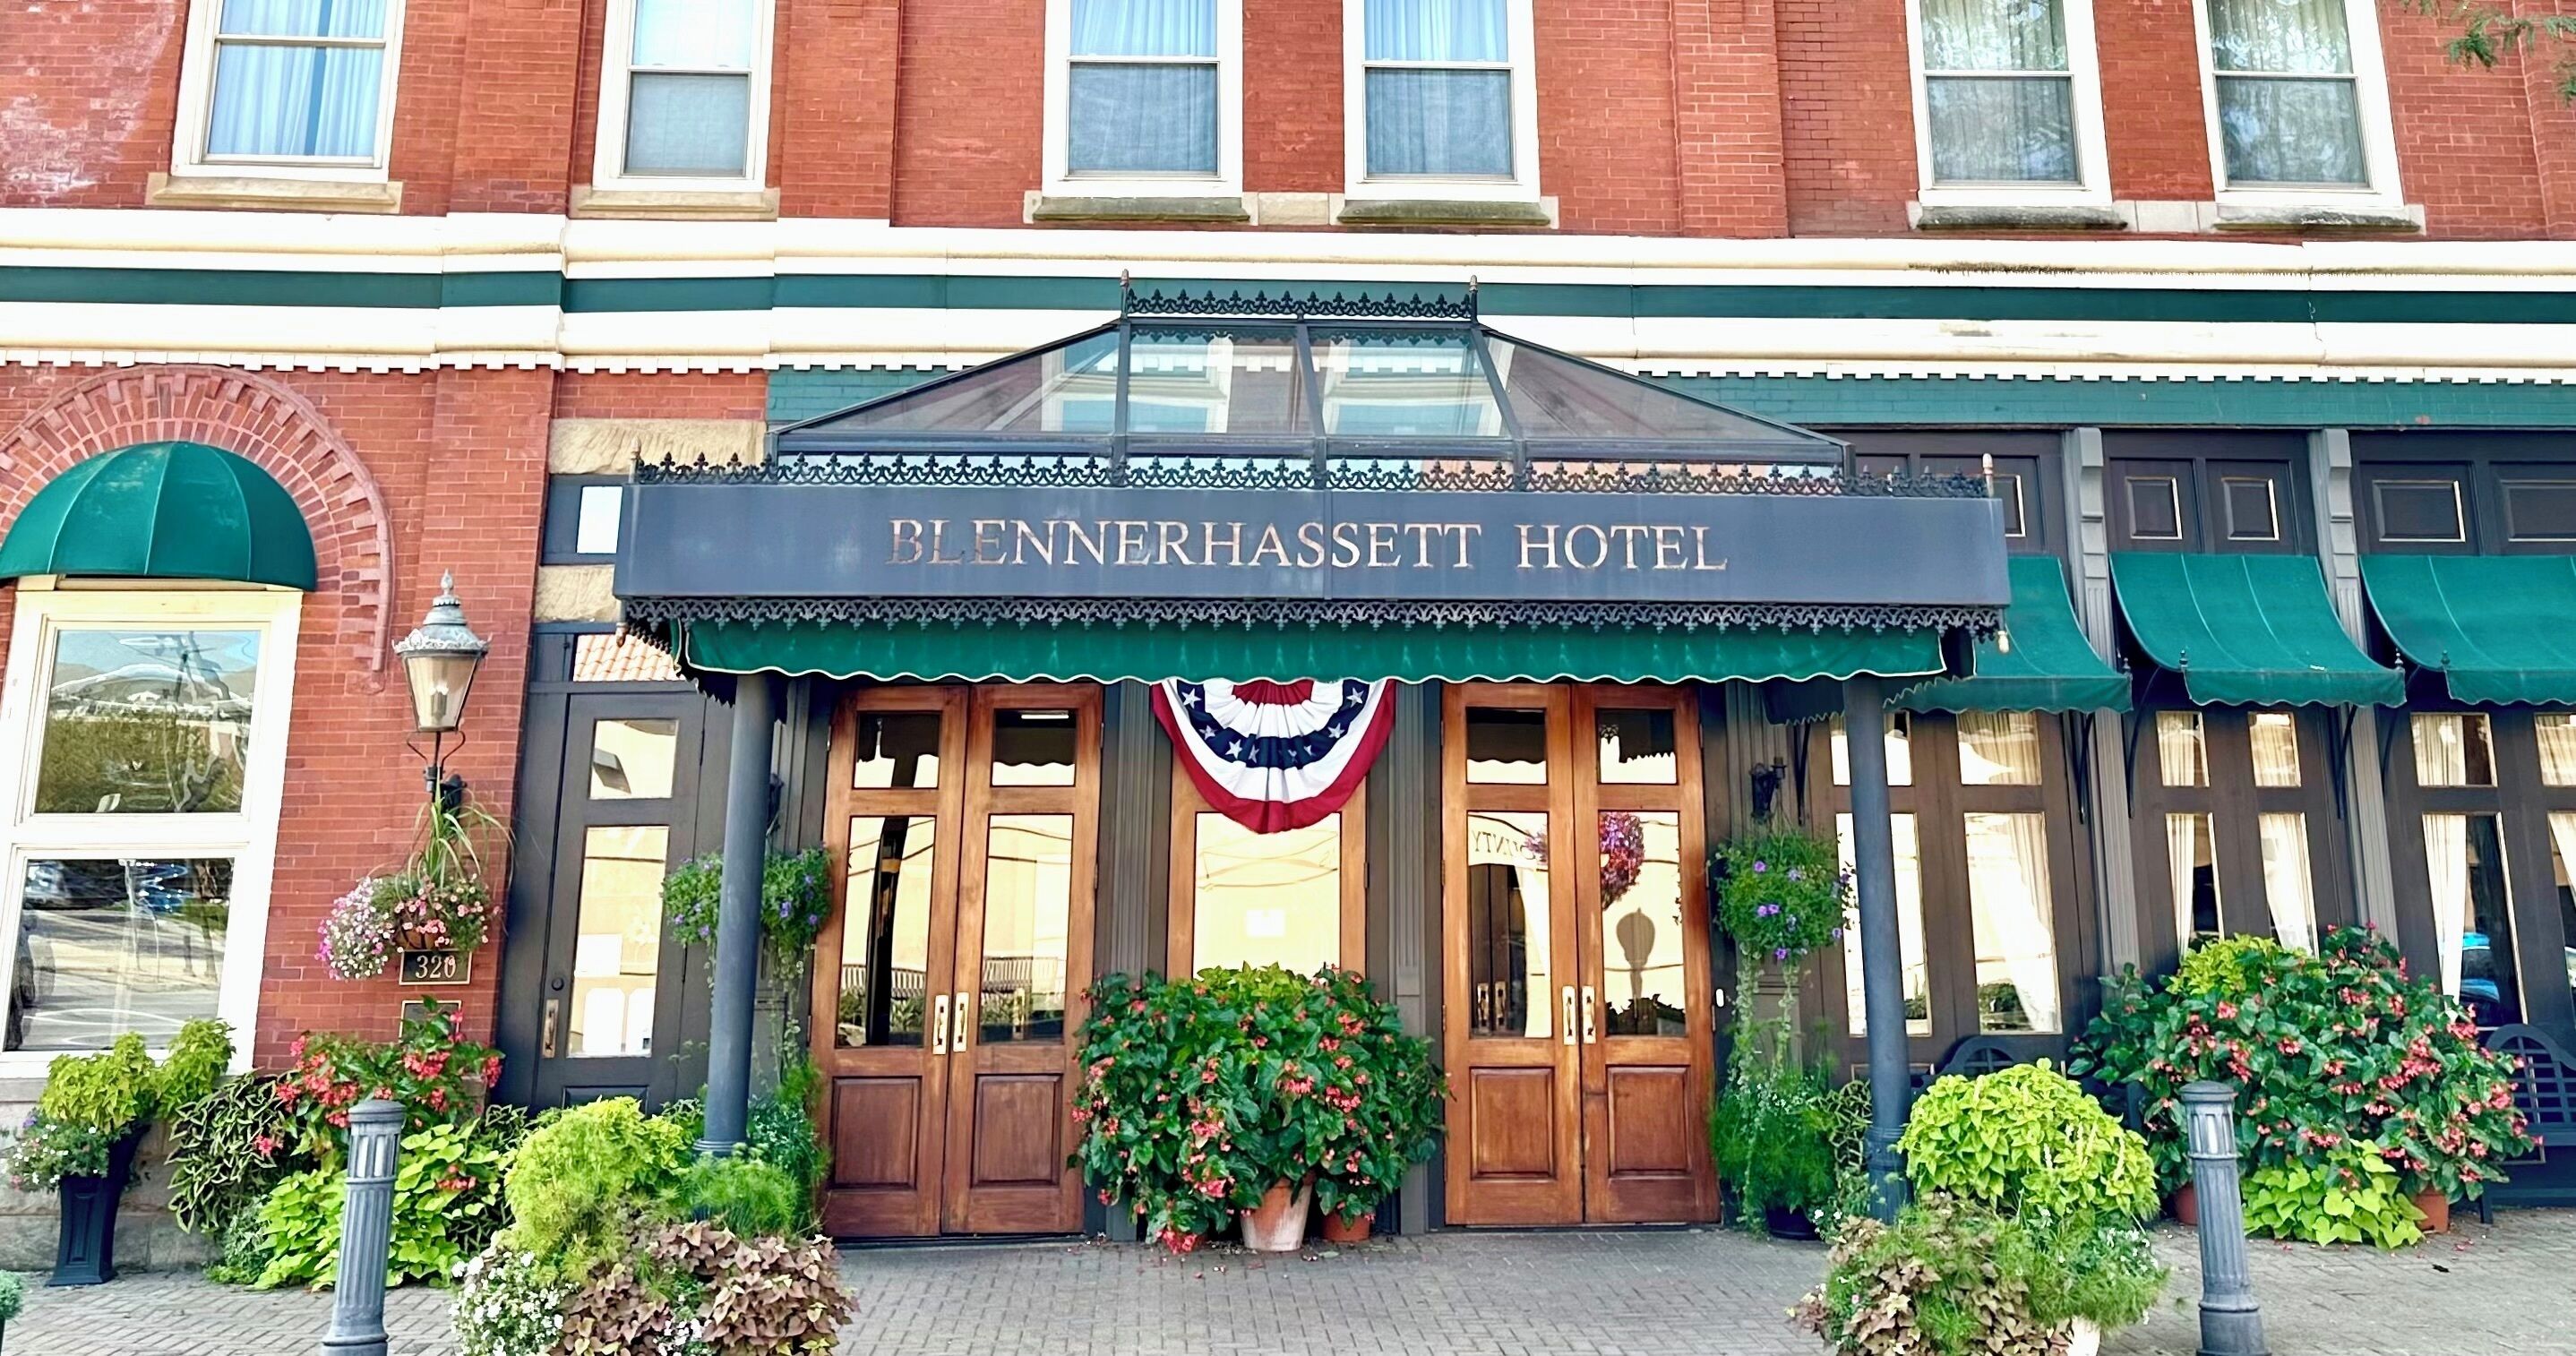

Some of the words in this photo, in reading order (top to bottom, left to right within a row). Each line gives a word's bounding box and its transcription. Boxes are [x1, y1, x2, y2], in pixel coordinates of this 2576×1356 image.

[885, 518, 1482, 570] BLENNERHASSETT
[1514, 522, 1728, 571] HOTEL
[415, 955, 456, 979] 320
